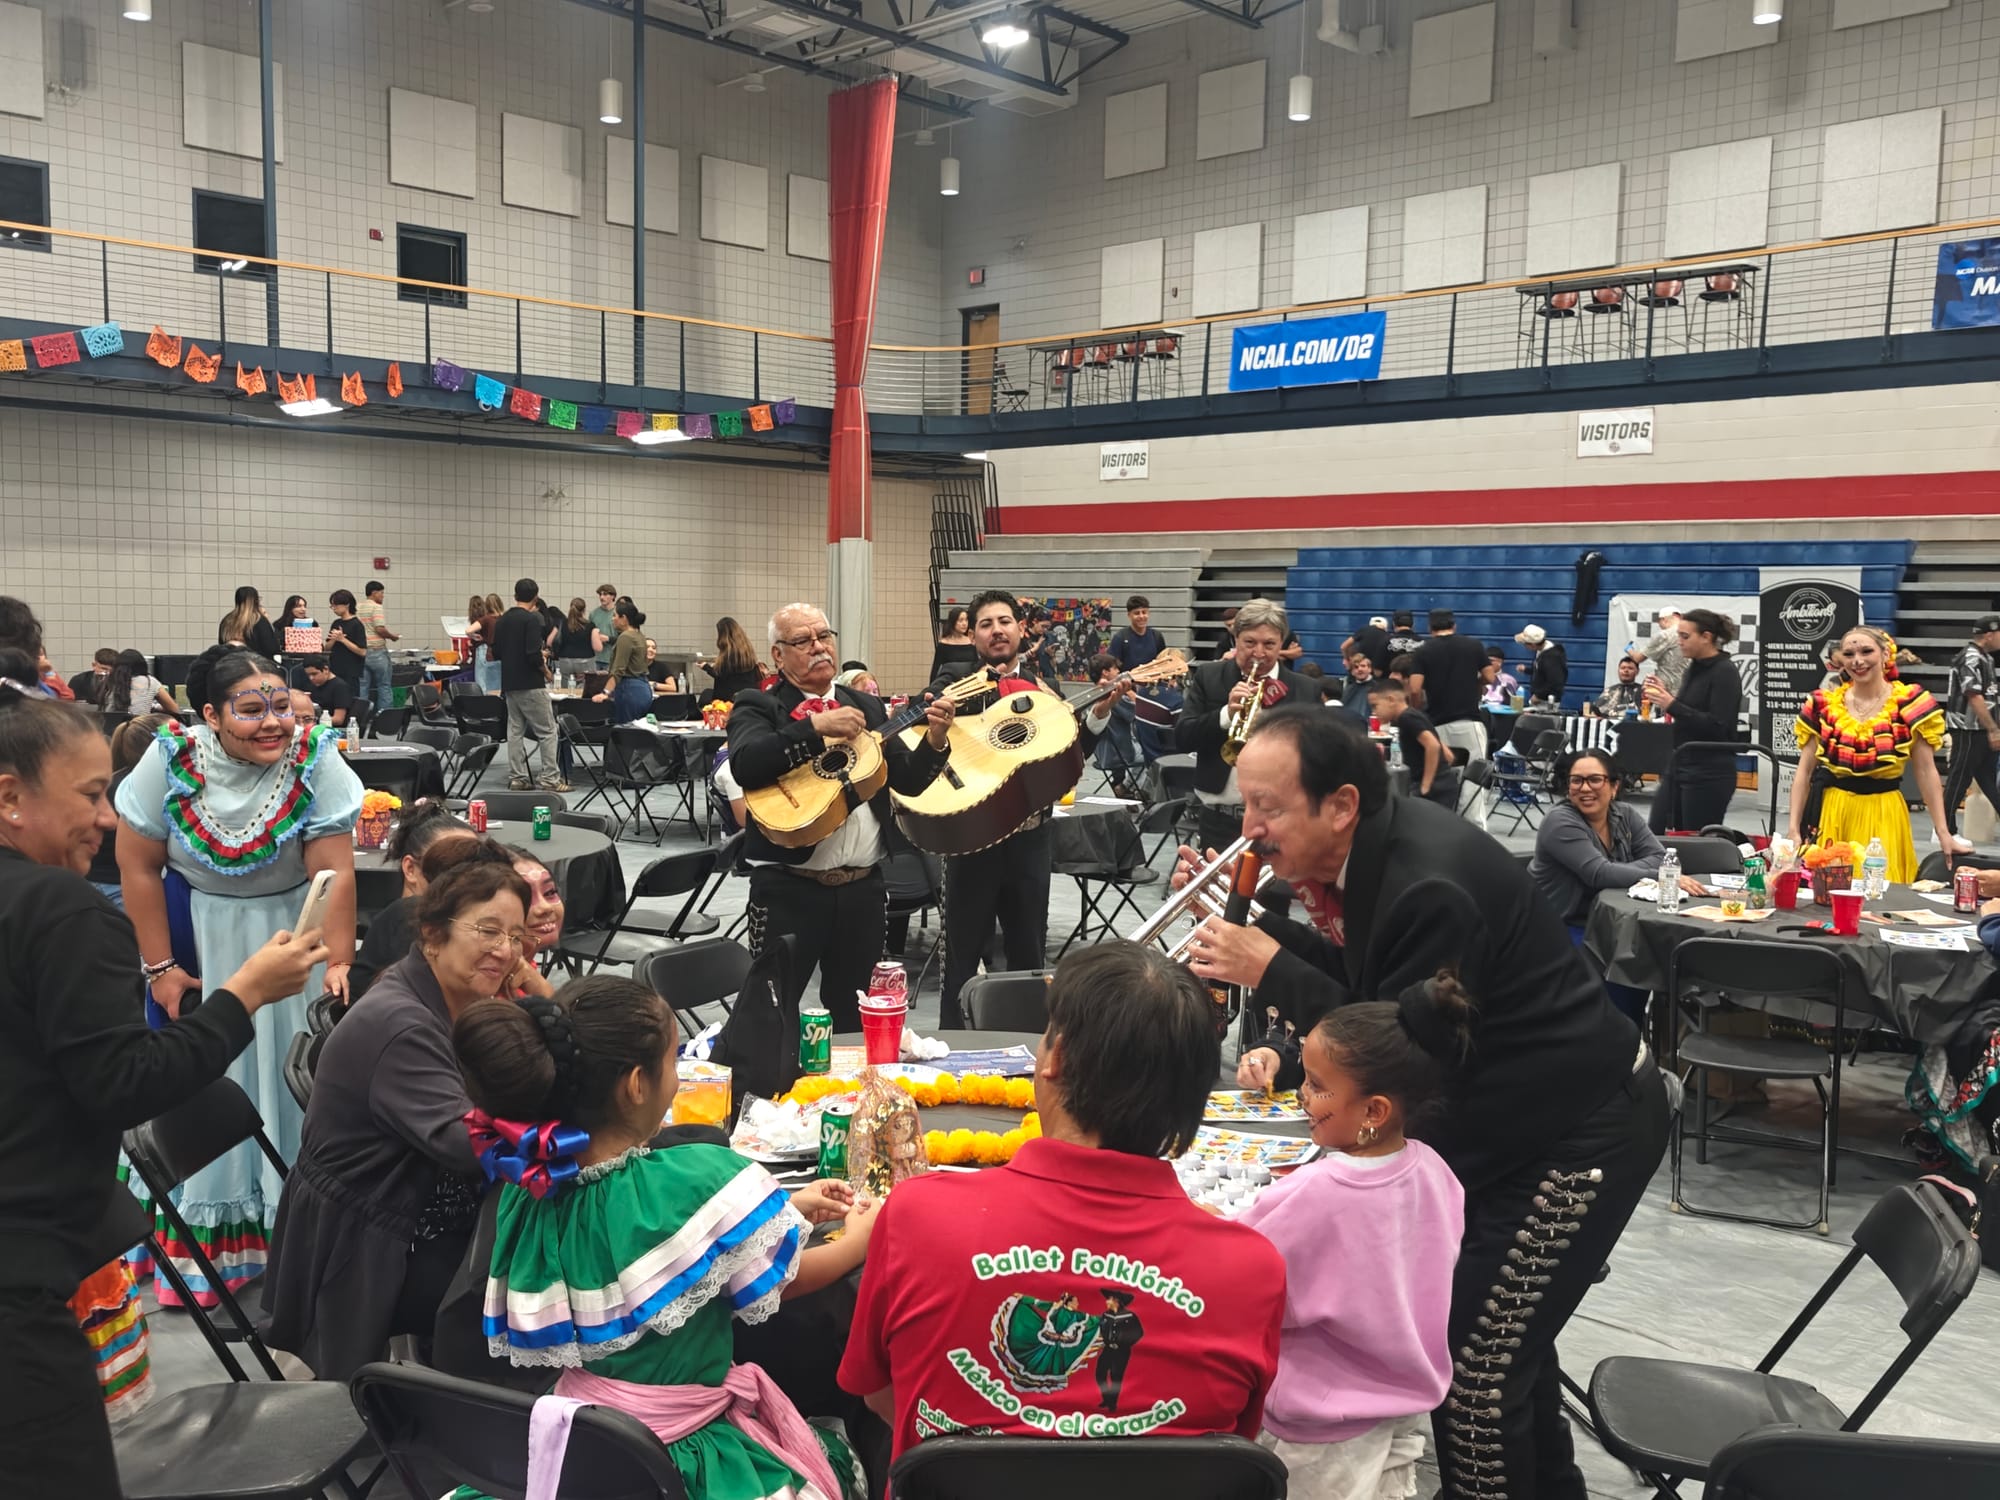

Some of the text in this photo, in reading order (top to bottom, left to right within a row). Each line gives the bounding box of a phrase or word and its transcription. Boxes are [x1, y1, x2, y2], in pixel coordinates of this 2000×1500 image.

[1239, 333, 1375, 371] NCAA.COM/D2
[1580, 421, 1651, 442] VISITORS
[1101, 452, 1147, 468] VISITORS
[1785, 643, 1812, 651] HAIRCUTS
[1781, 653, 1808, 661] HAIRCUTS
[1784, 662, 1798, 670] HAIR
[1798, 663, 1817, 671] COLOR
[1785, 691, 1798, 699] LINE
[821, 1122, 848, 1150] Sp
[972, 1246, 1204, 1318] Ballet Folklórico
[947, 1348, 1187, 1438] México en el Corazón
